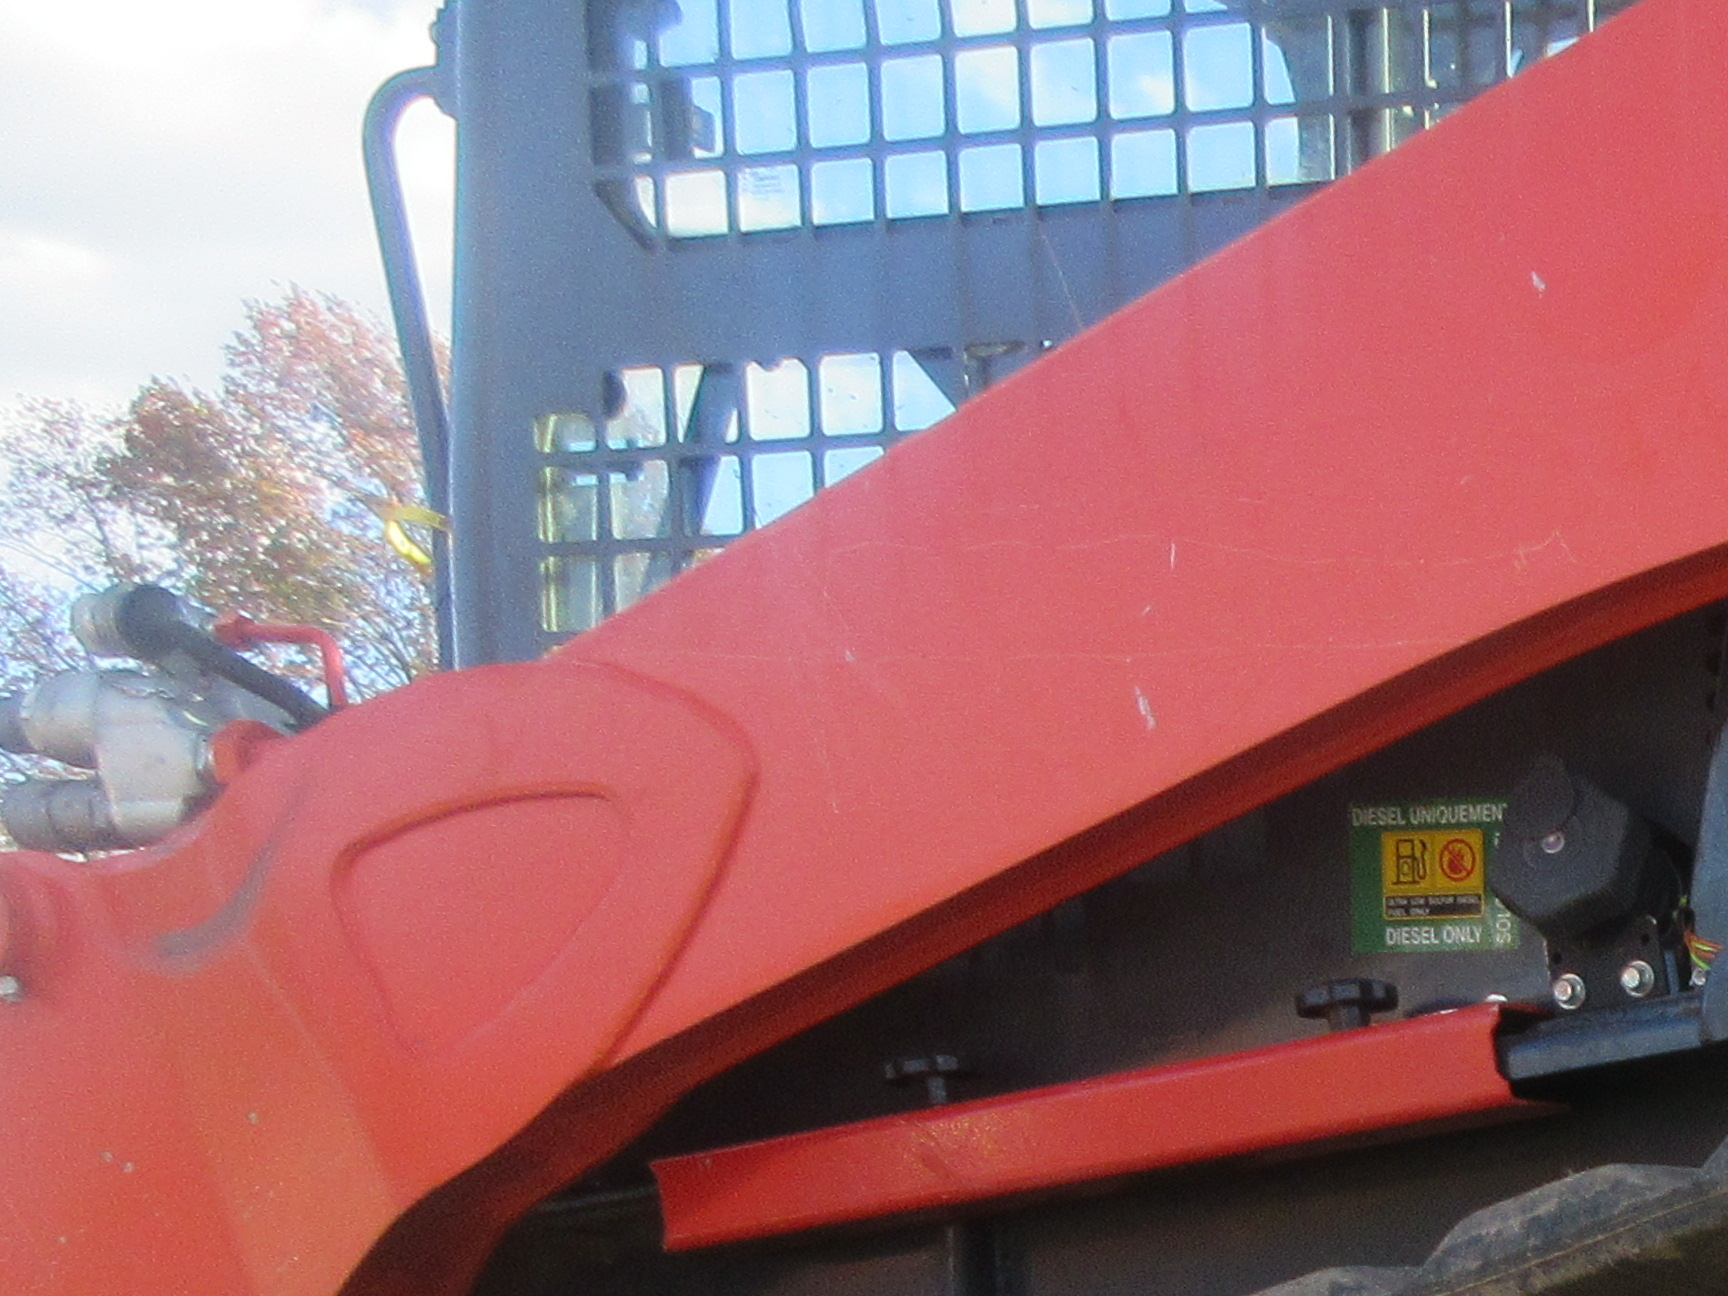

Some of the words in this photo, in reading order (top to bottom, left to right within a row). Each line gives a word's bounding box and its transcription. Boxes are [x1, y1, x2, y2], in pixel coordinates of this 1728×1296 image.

[1351, 808, 1406, 827] DIESEL
[1409, 803, 1507, 825] UNIQUEMEN
[1385, 926, 1440, 945] DIESEL
[1442, 925, 1482, 944] ONLY
